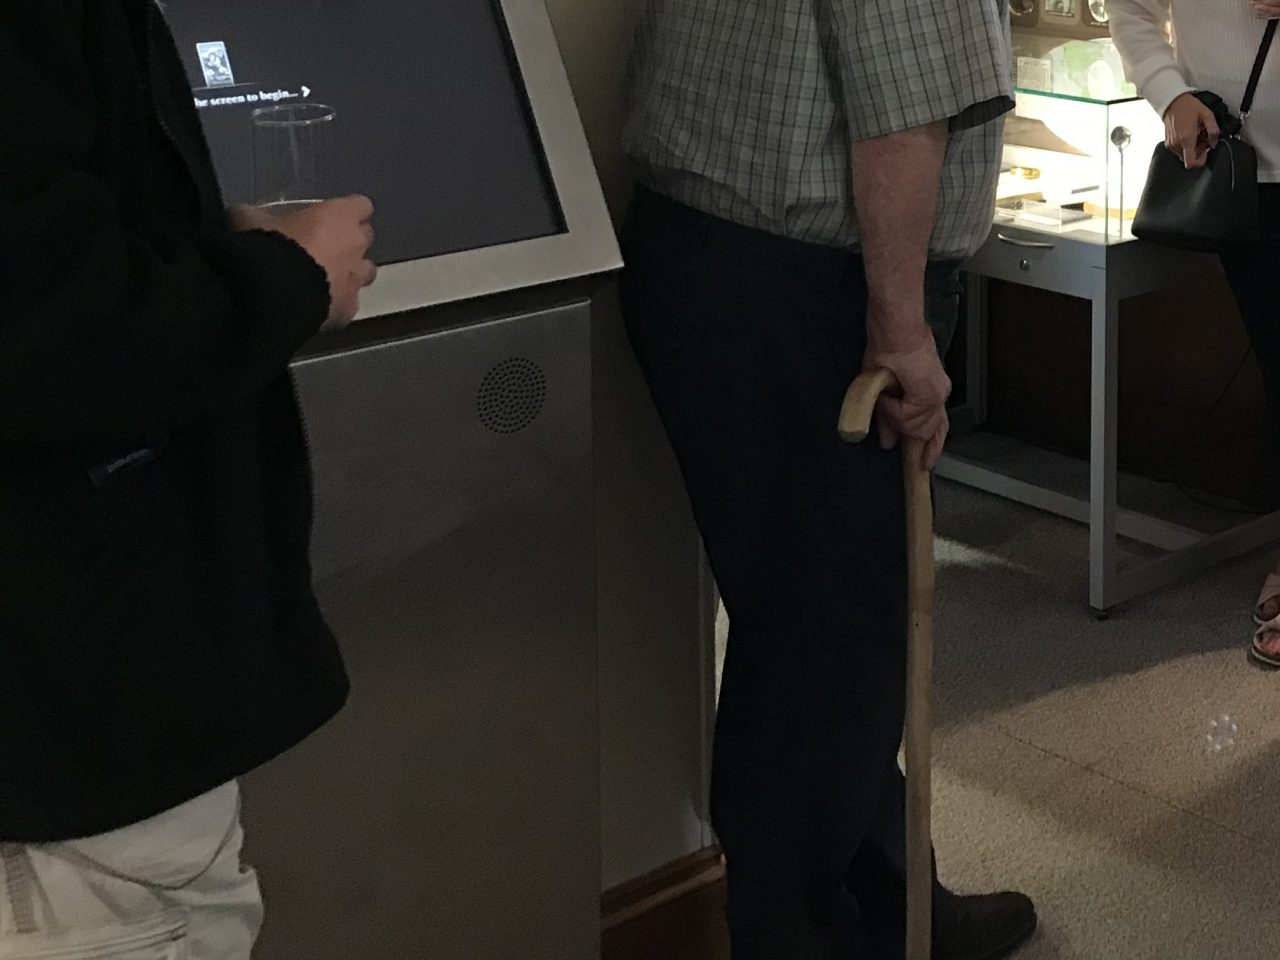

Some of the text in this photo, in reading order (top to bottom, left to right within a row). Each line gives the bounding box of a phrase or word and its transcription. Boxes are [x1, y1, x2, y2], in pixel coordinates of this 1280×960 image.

[194, 97, 208, 107] he
[210, 94, 245, 106] screen
[246, 93, 259, 102] to
